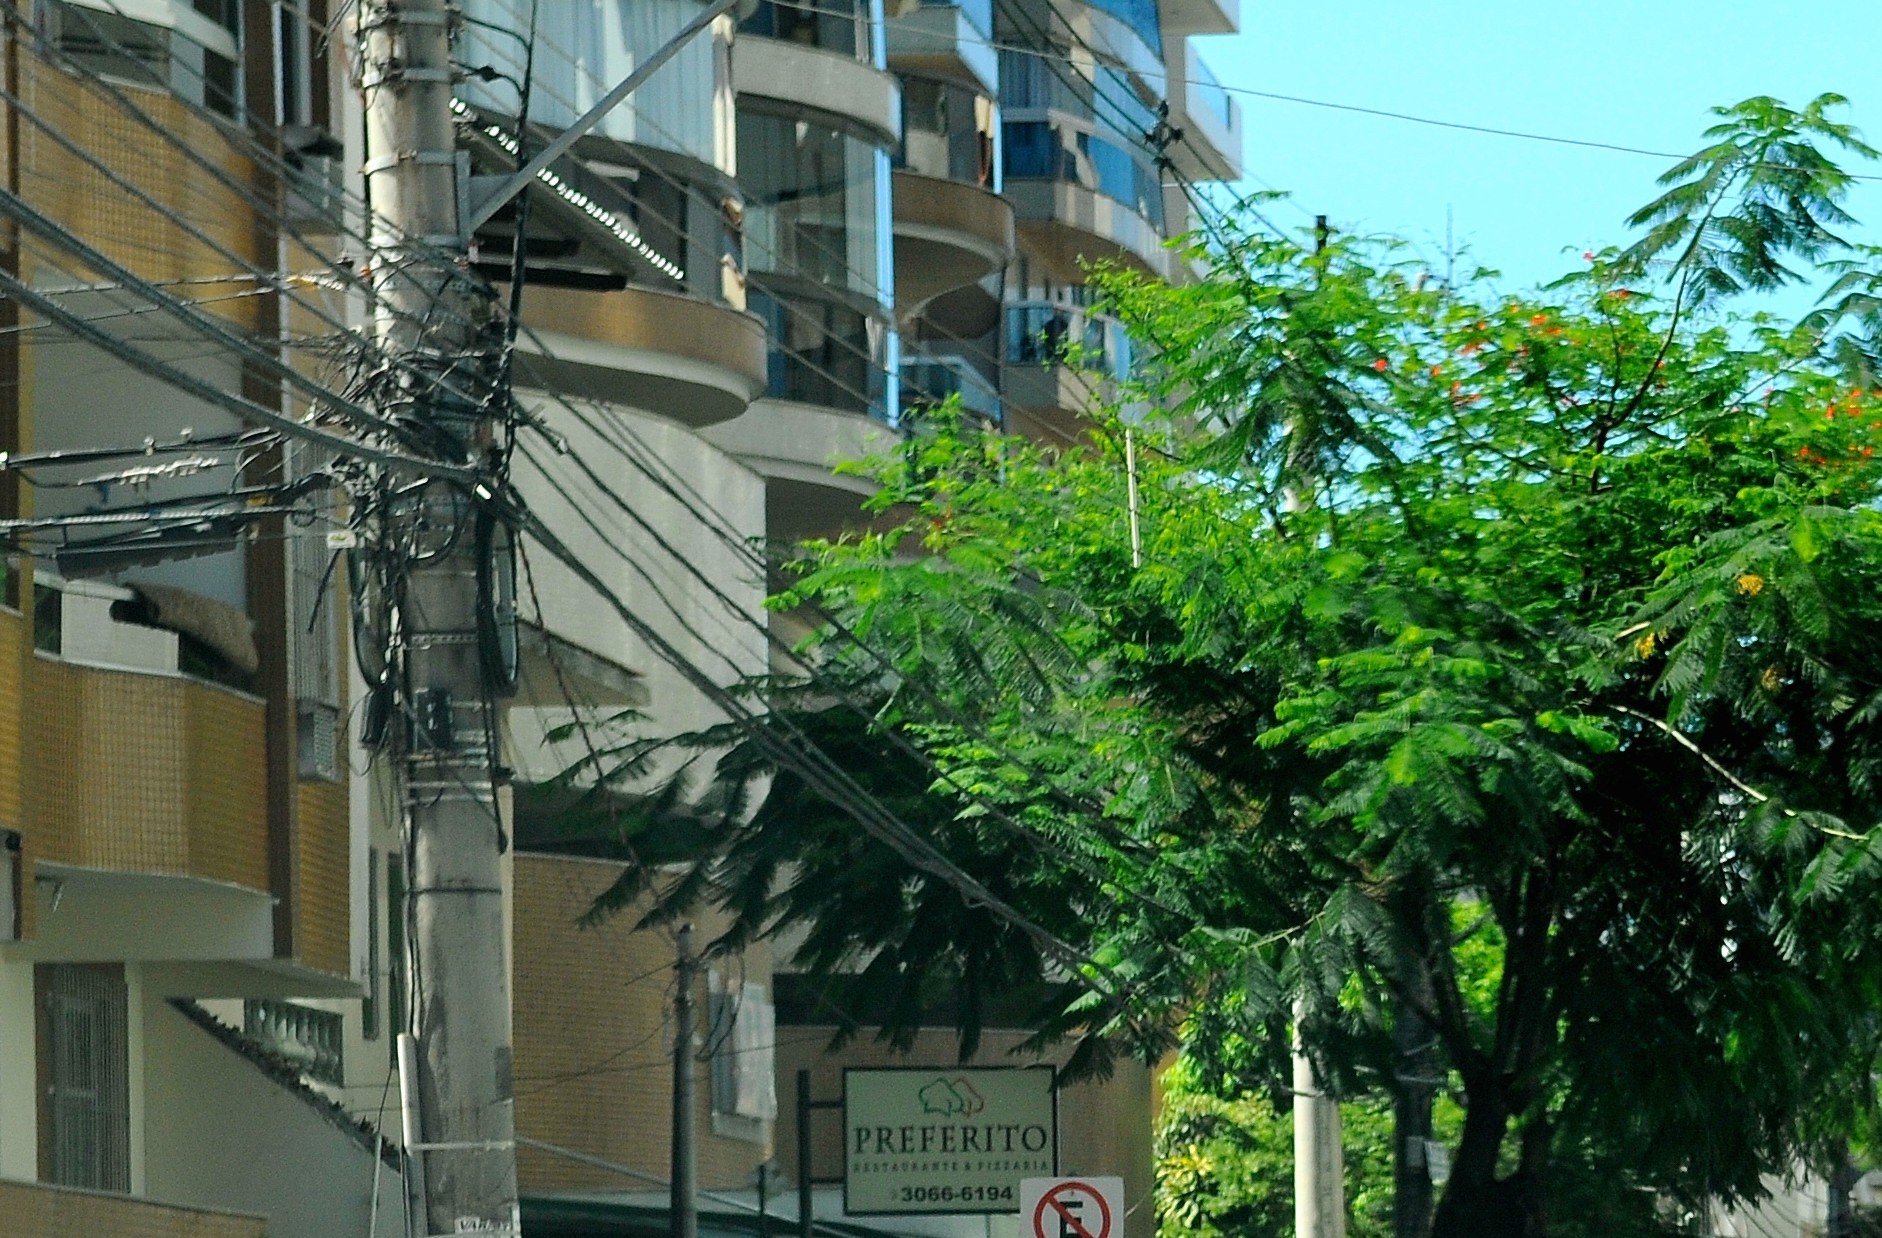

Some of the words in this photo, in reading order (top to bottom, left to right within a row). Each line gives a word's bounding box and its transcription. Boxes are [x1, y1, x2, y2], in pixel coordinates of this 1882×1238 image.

[853, 1124, 1048, 1154] PREFERITO
[853, 1160, 958, 1173] RESTAURANTE
[978, 1160, 1049, 1171] PIZZARIA
[901, 1186, 1014, 1202] 3066-6194
